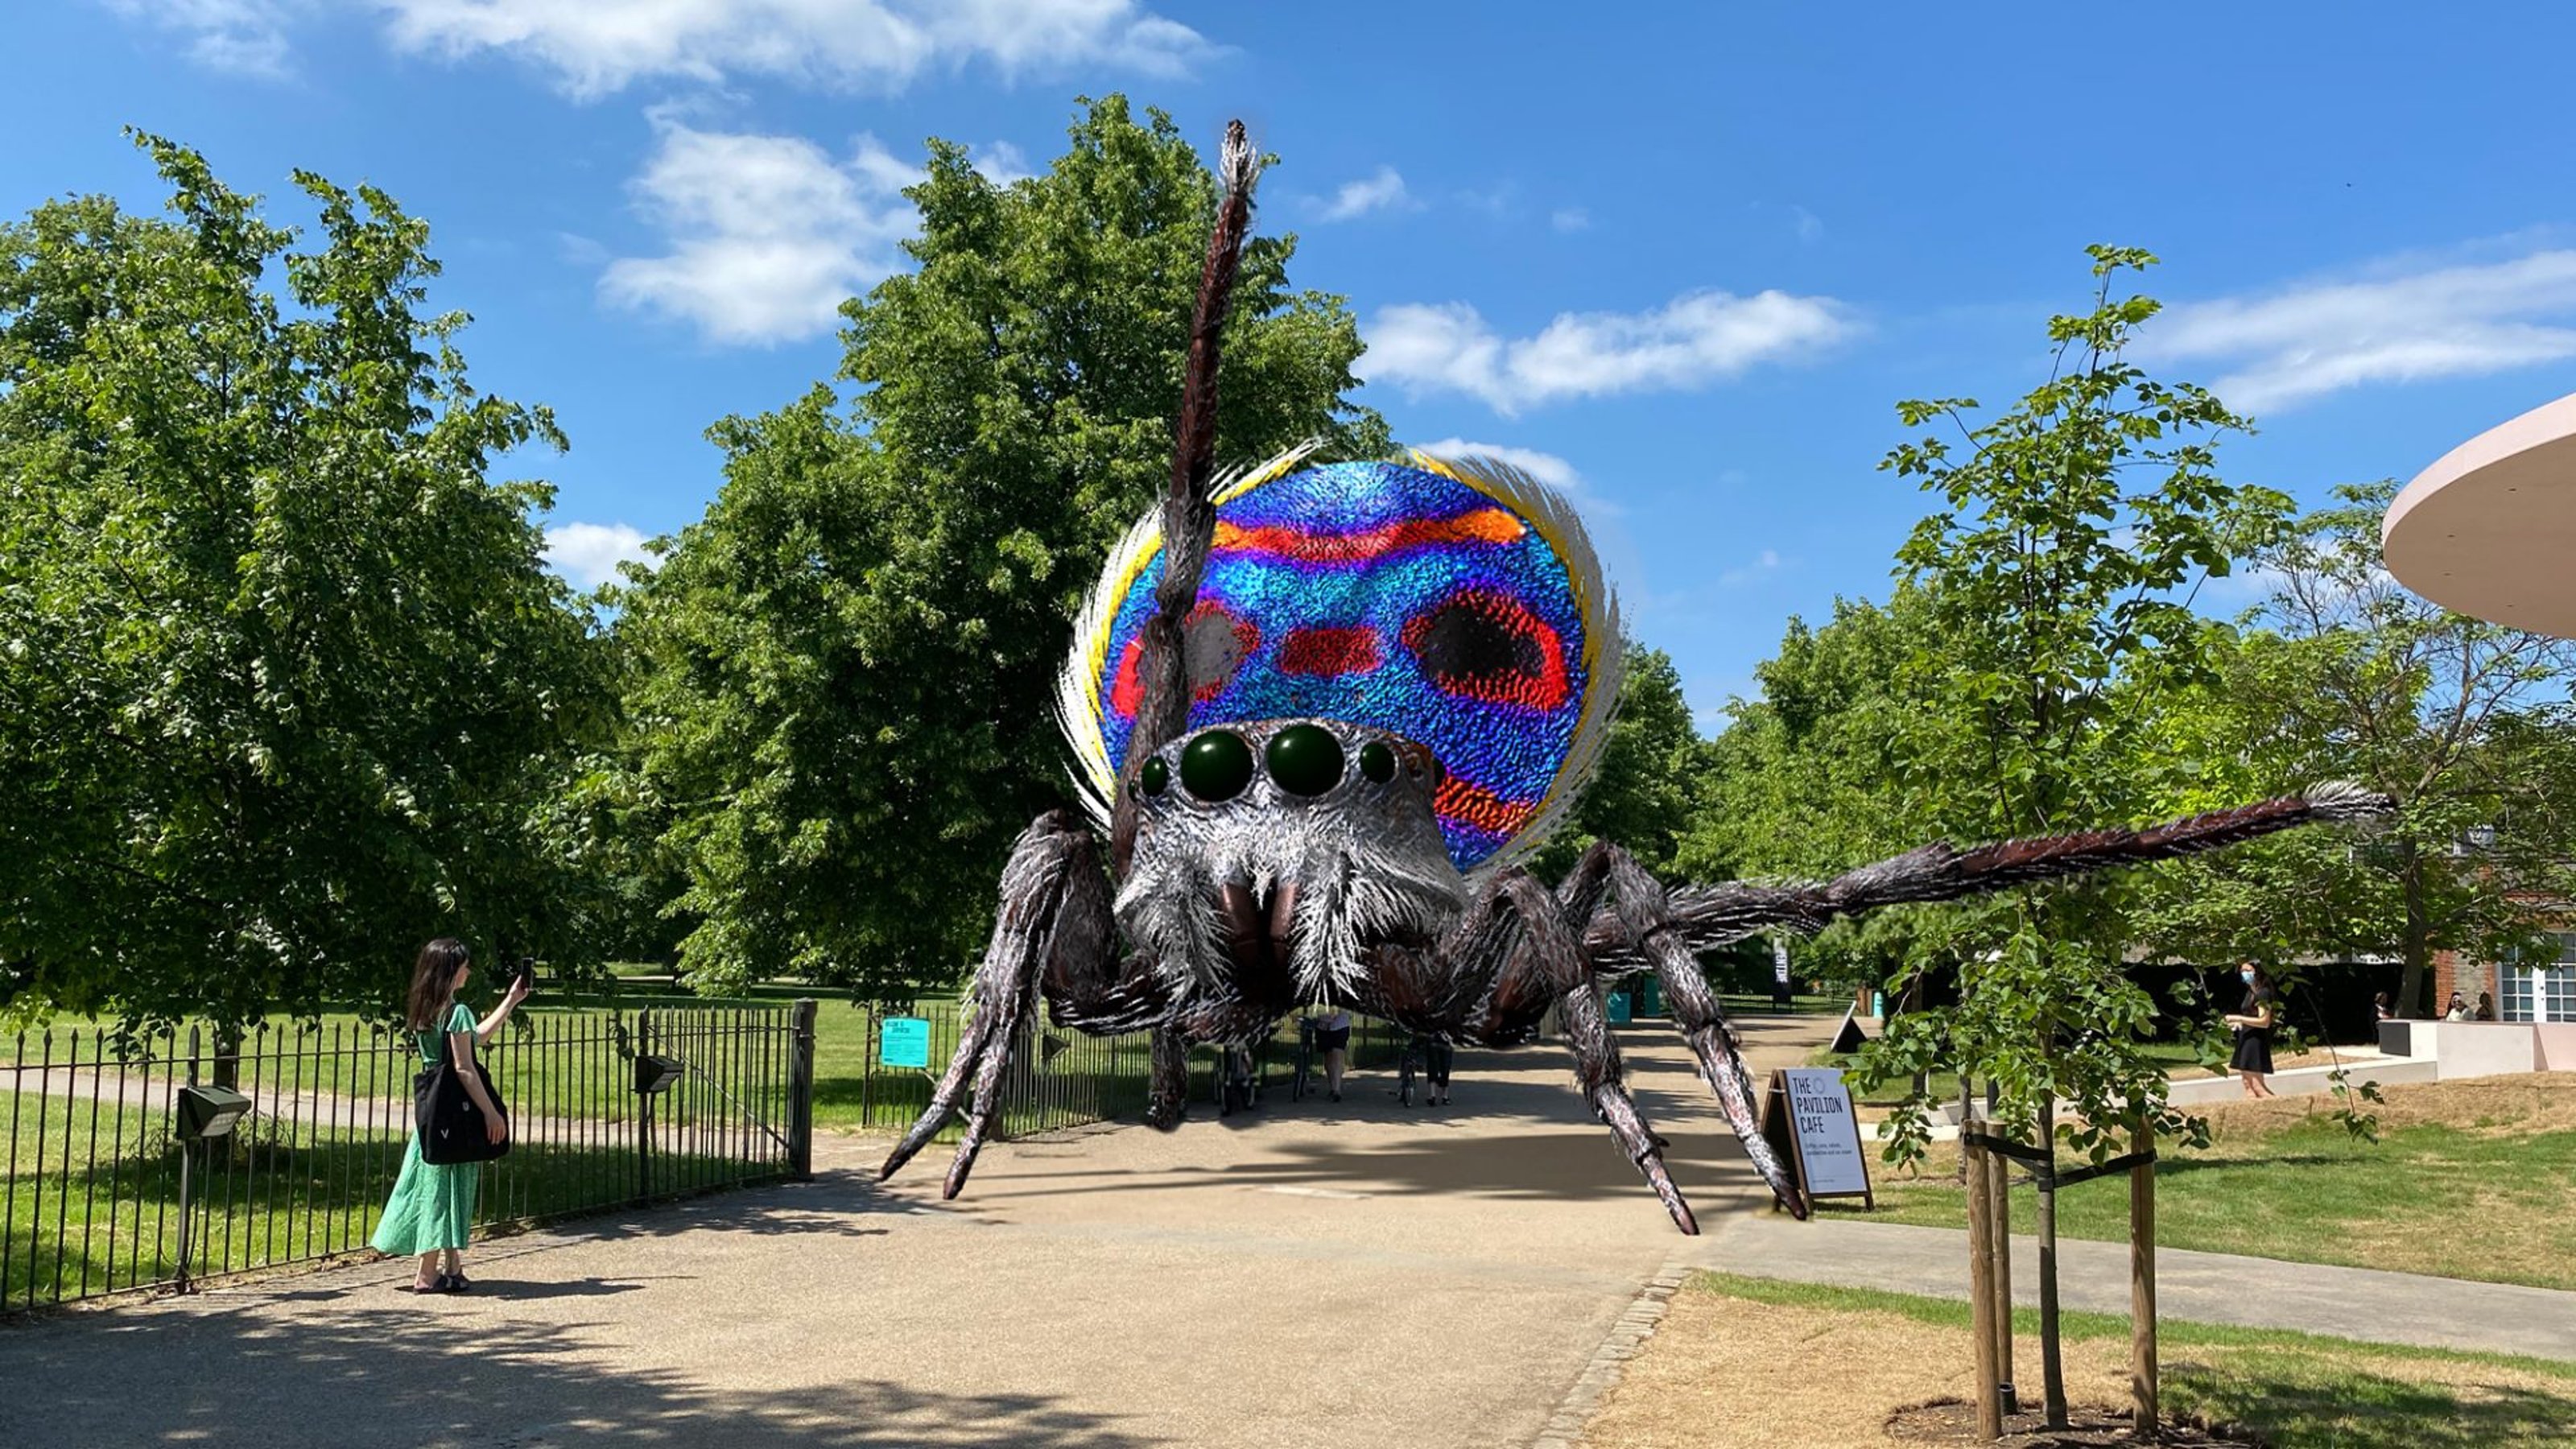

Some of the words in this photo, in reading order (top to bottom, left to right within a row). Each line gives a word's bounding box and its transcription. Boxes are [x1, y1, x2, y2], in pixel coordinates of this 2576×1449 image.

[1792, 1077, 1811, 1094] THE
[1796, 1096, 1843, 1114] PAVILION
[1800, 1116, 1825, 1134] CAFE
